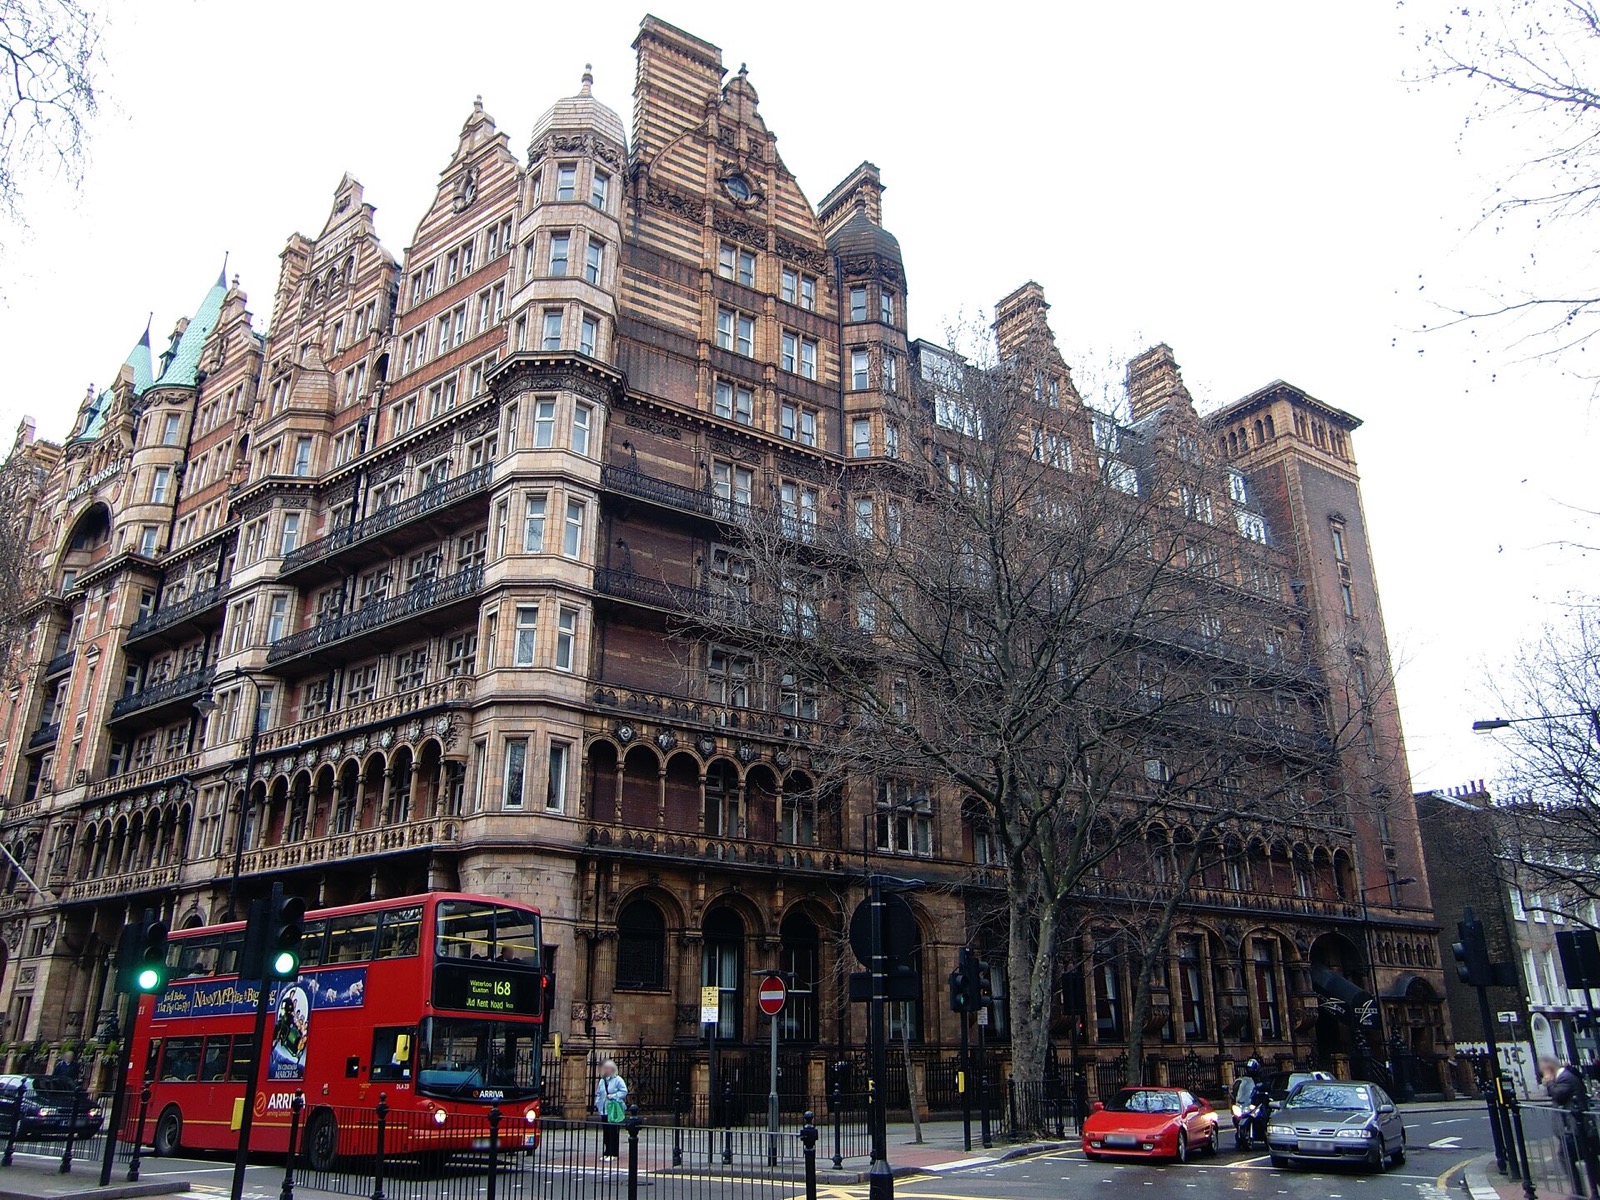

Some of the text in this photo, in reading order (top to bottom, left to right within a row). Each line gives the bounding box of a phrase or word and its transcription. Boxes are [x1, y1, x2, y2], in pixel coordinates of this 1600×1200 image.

[66, 459, 121, 502] HOTEL RUSSELL
[469, 979, 492, 988] Waterloo
[494, 981, 511, 996] 168
[476, 998, 489, 1008] Kent
[274, 1070, 292, 1079] MARCH
[479, 1090, 504, 1098] ARRIVA
